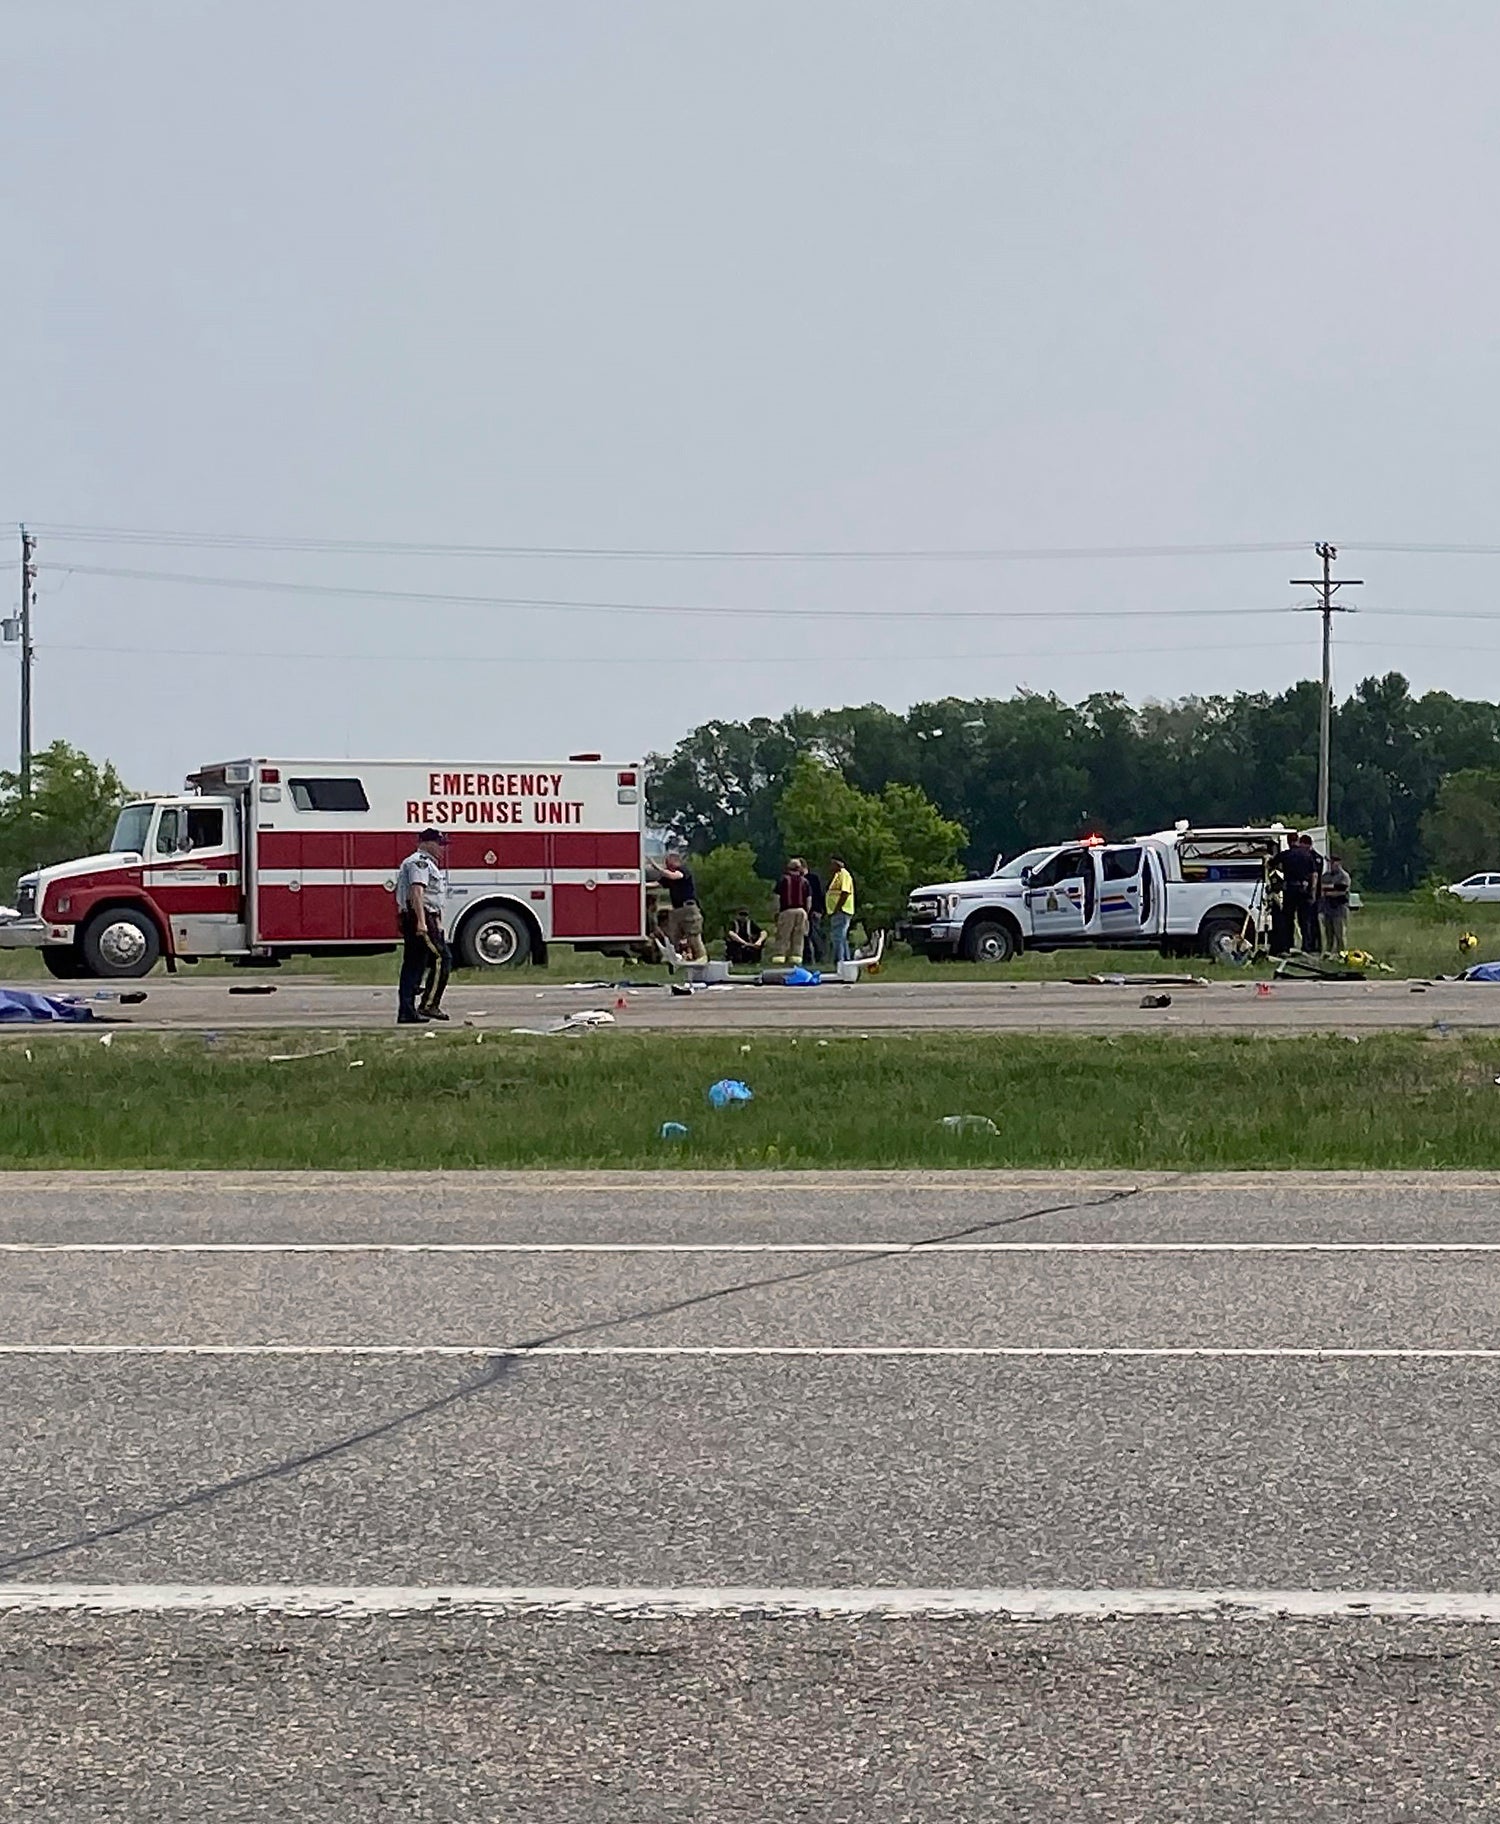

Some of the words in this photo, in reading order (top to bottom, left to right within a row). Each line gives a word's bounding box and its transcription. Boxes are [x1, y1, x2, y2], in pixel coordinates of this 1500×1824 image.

[429, 773, 563, 796] EMERGENCY
[406, 801, 523, 824] RESPONSE
[533, 802, 585, 824] UNIT
